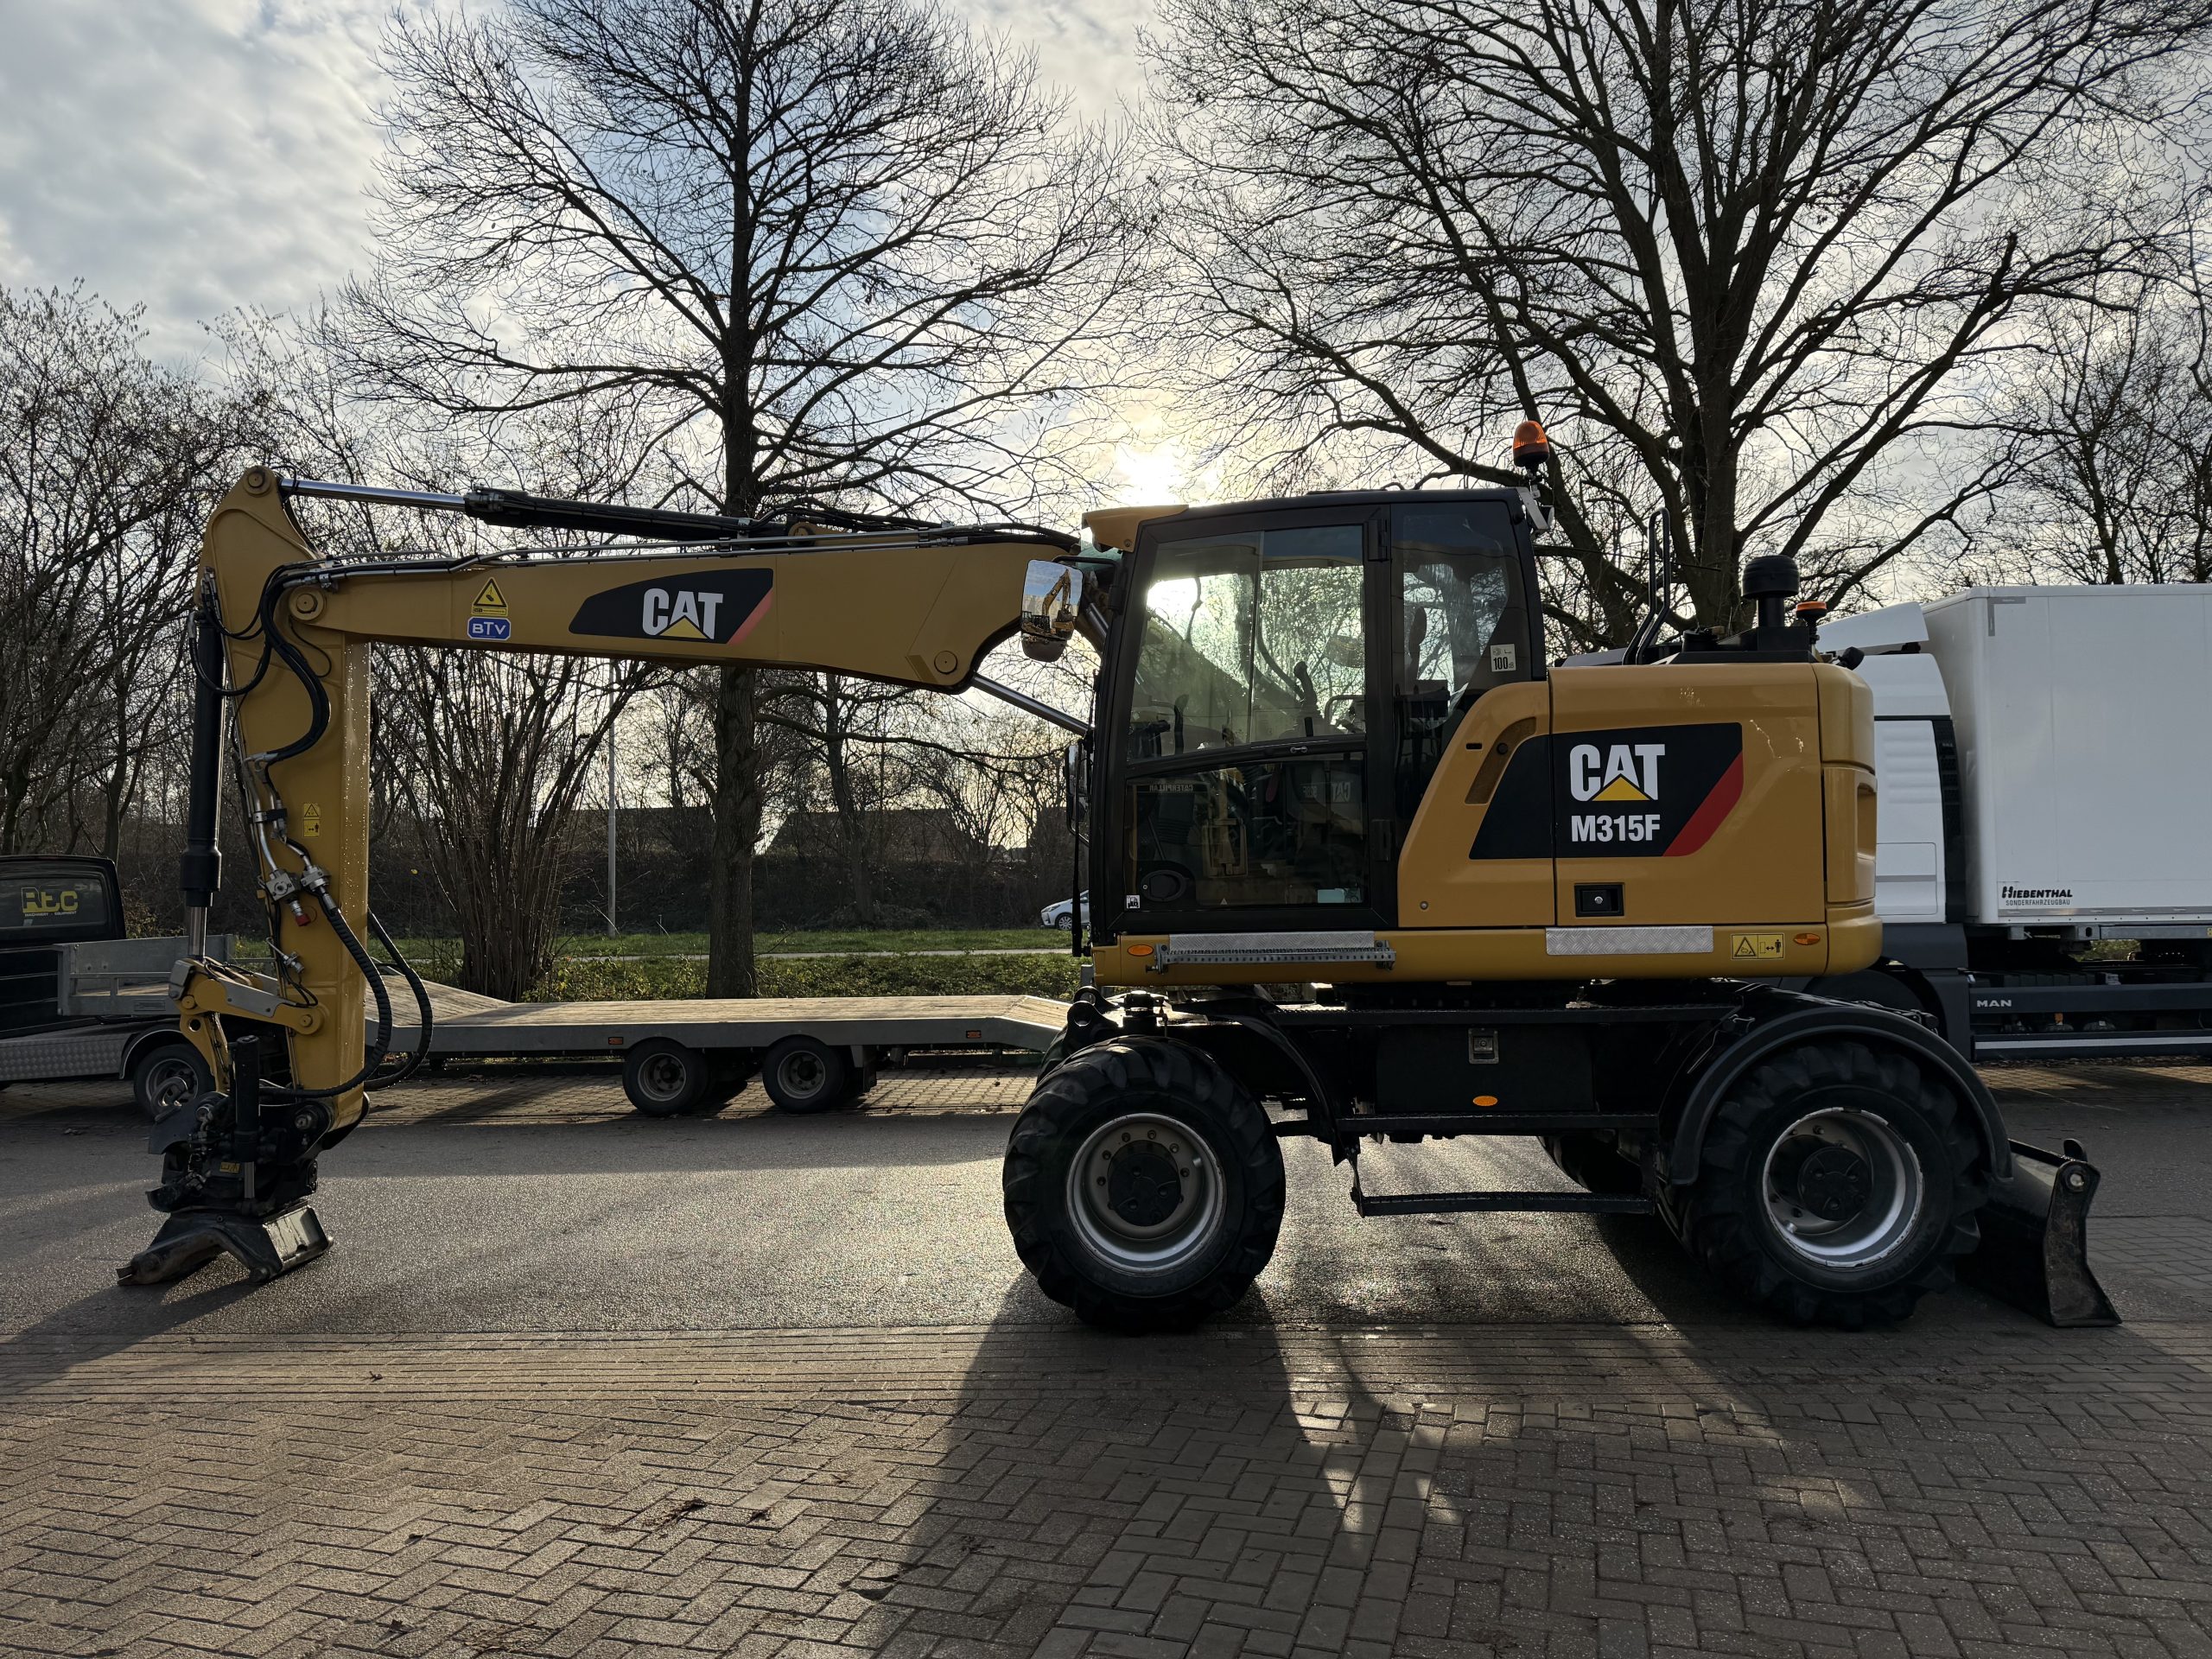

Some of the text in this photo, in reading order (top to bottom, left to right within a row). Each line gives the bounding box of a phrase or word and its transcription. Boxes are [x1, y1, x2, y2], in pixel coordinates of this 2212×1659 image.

[642, 588, 724, 640] CAT
[472, 621, 506, 636] BTV
[1493, 657, 1509, 670] 100
[1569, 743, 1666, 802] CAT
[1571, 814, 1661, 842] M315F
[2001, 886, 2073, 899] HIEBENTHAL
